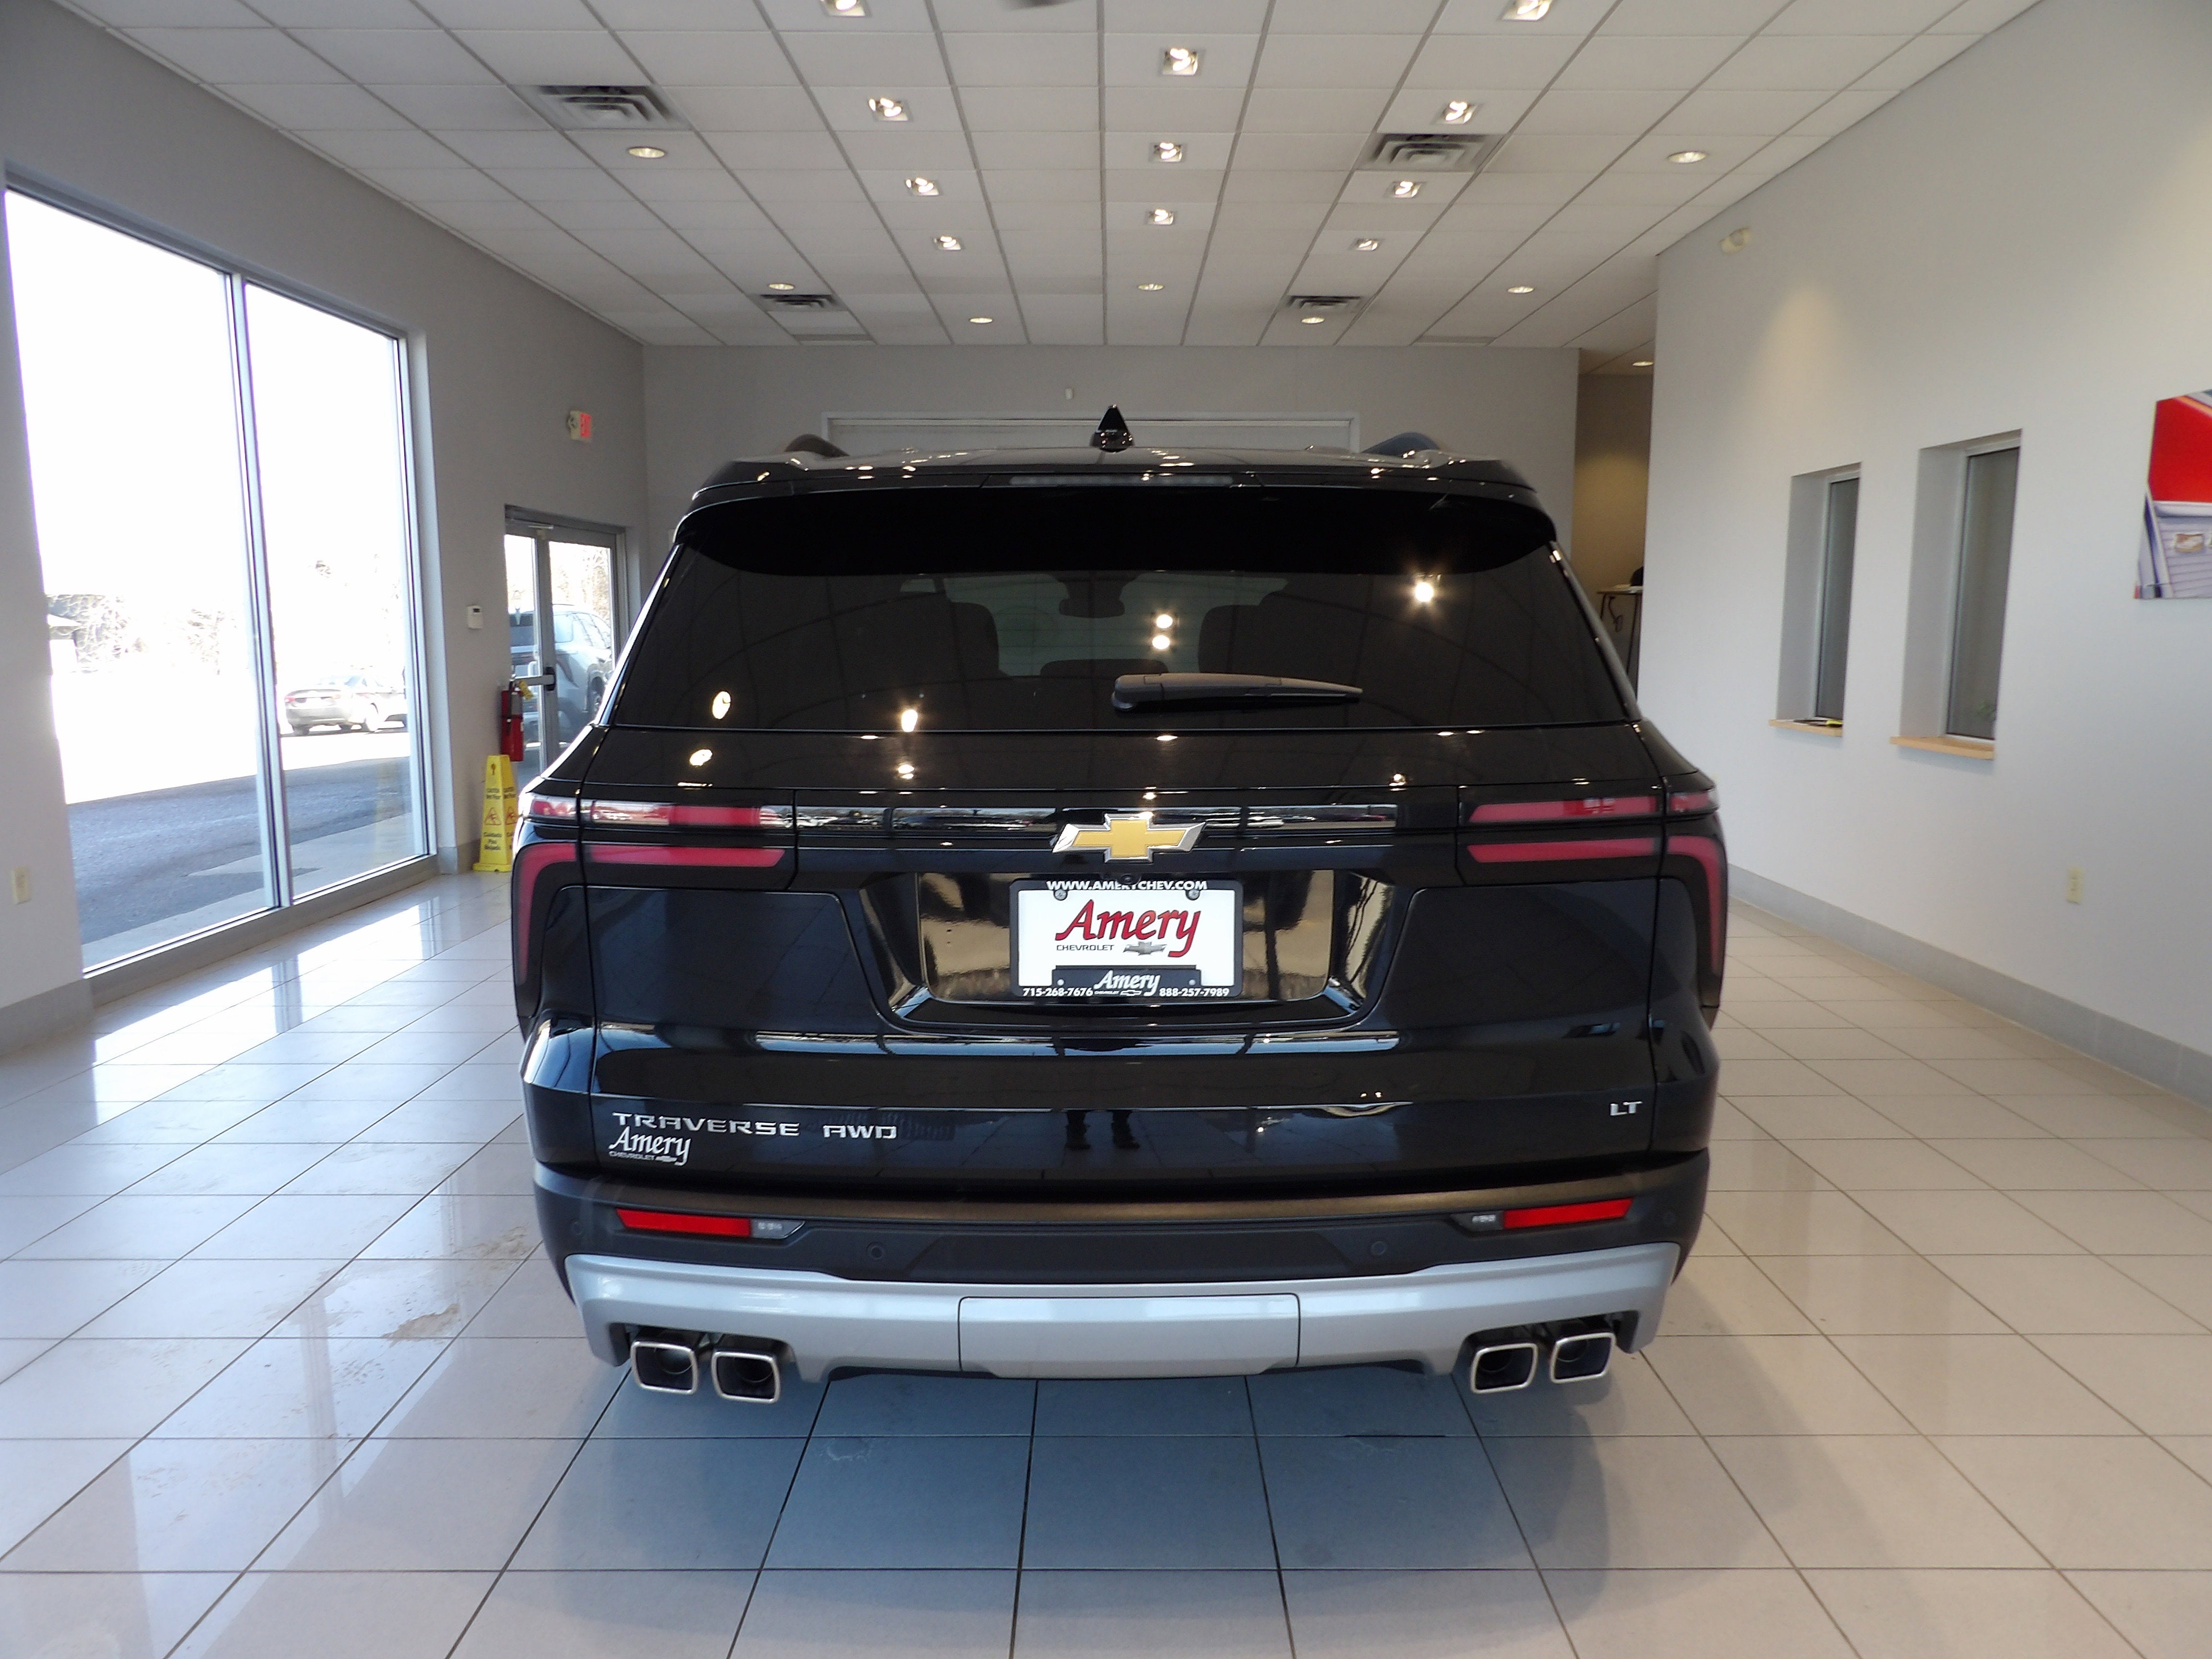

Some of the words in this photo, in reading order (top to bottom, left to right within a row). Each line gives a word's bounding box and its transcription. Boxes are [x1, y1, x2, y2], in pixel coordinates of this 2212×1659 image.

[1055, 899, 1202, 958] Amery
[1022, 987, 1093, 997] 715-268-7676
[1094, 970, 1161, 997] Amery
[1159, 987, 1229, 997] 888-257-7989
[1610, 1101, 1643, 1116] LT
[612, 1112, 800, 1136] TRAVERSE
[823, 1125, 897, 1139] AWD
[608, 1126, 691, 1166] Amery
